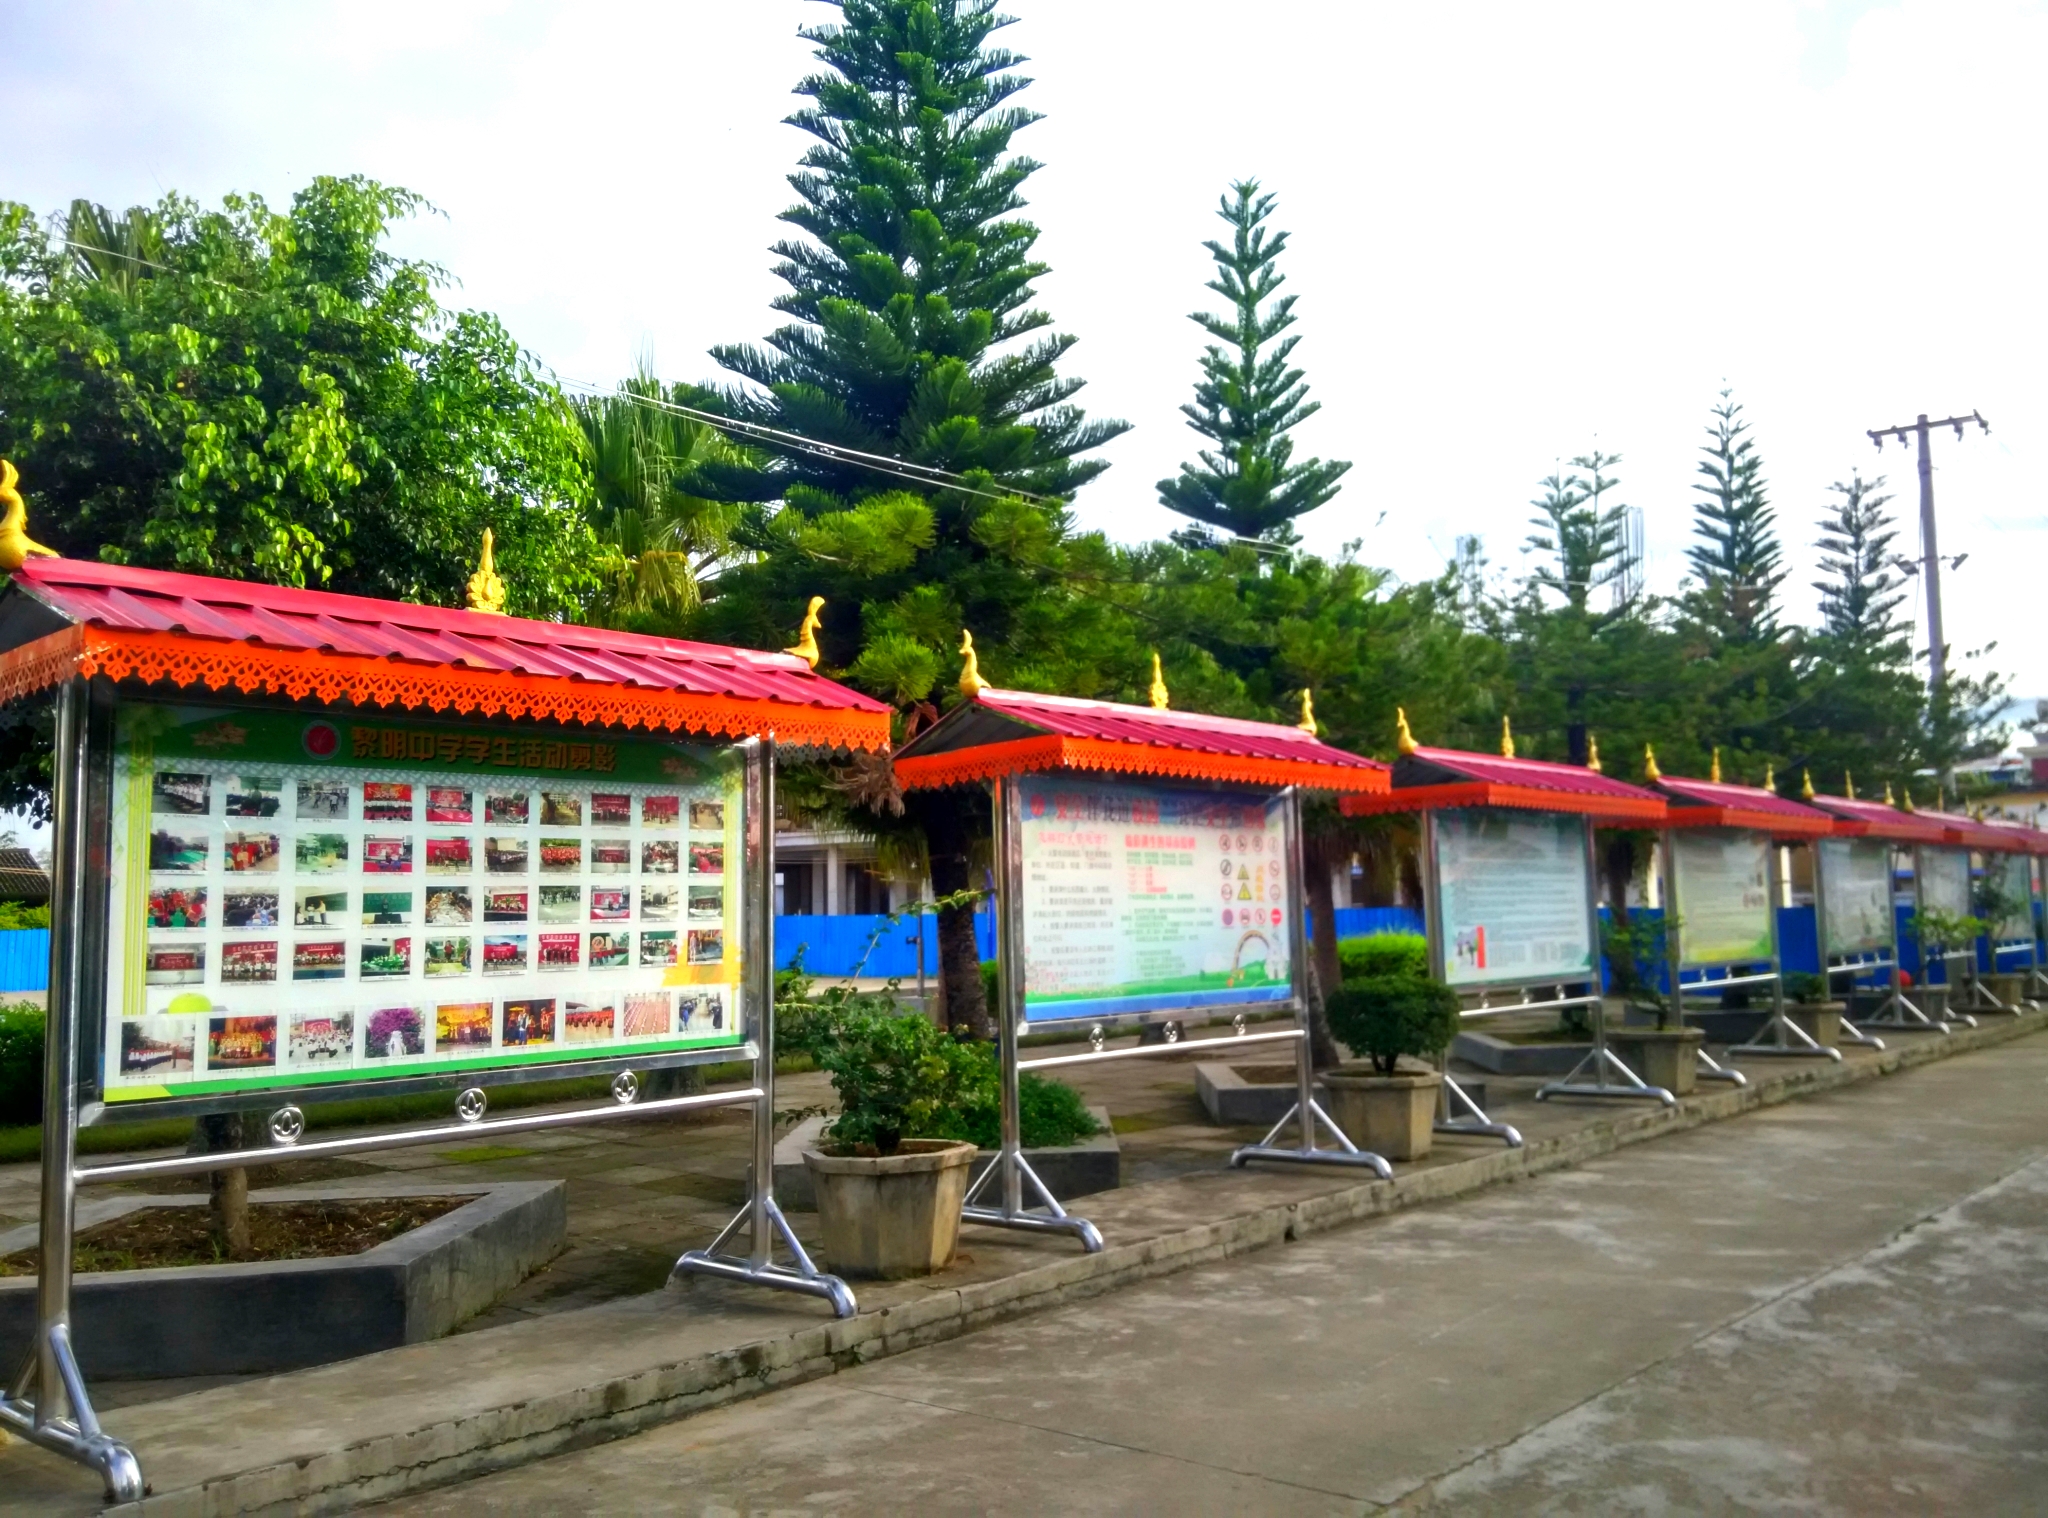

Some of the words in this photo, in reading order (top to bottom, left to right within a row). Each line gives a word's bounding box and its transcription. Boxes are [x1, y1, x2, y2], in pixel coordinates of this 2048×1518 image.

[351, 726, 617, 772] 黎明中学学生活动剪影
